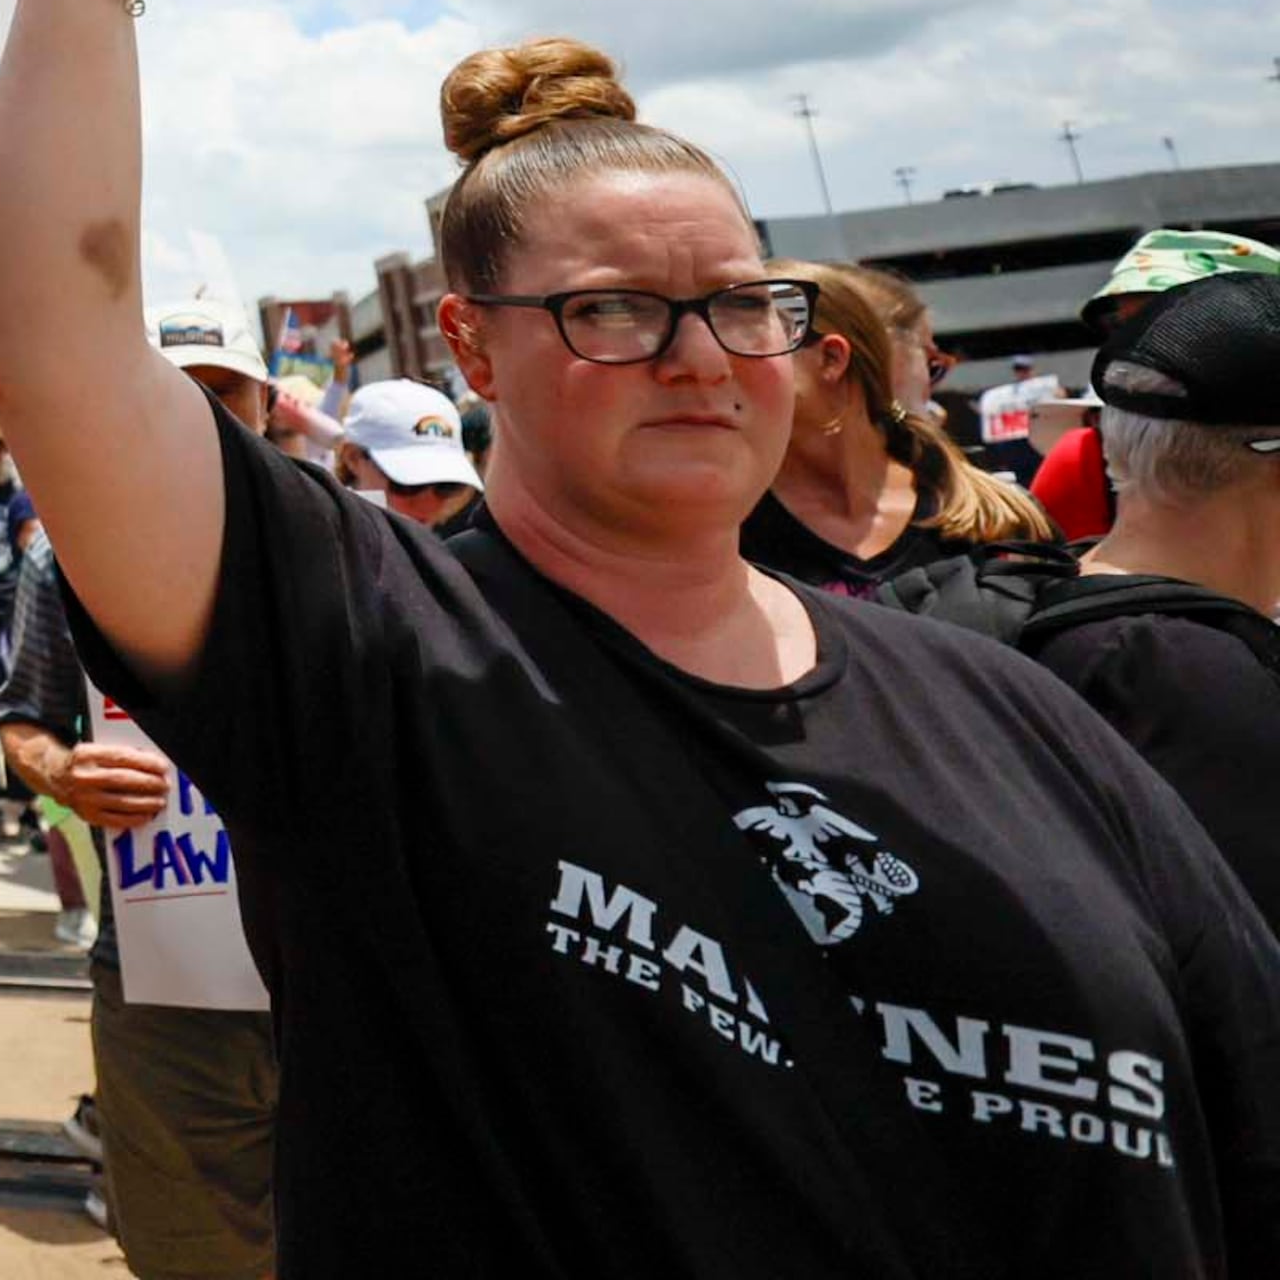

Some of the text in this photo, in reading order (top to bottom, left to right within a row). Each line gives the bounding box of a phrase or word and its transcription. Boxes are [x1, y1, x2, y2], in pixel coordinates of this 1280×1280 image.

[113, 830, 229, 889] LAW
[546, 922, 660, 991] THE
[681, 982, 793, 1067] FEW.
